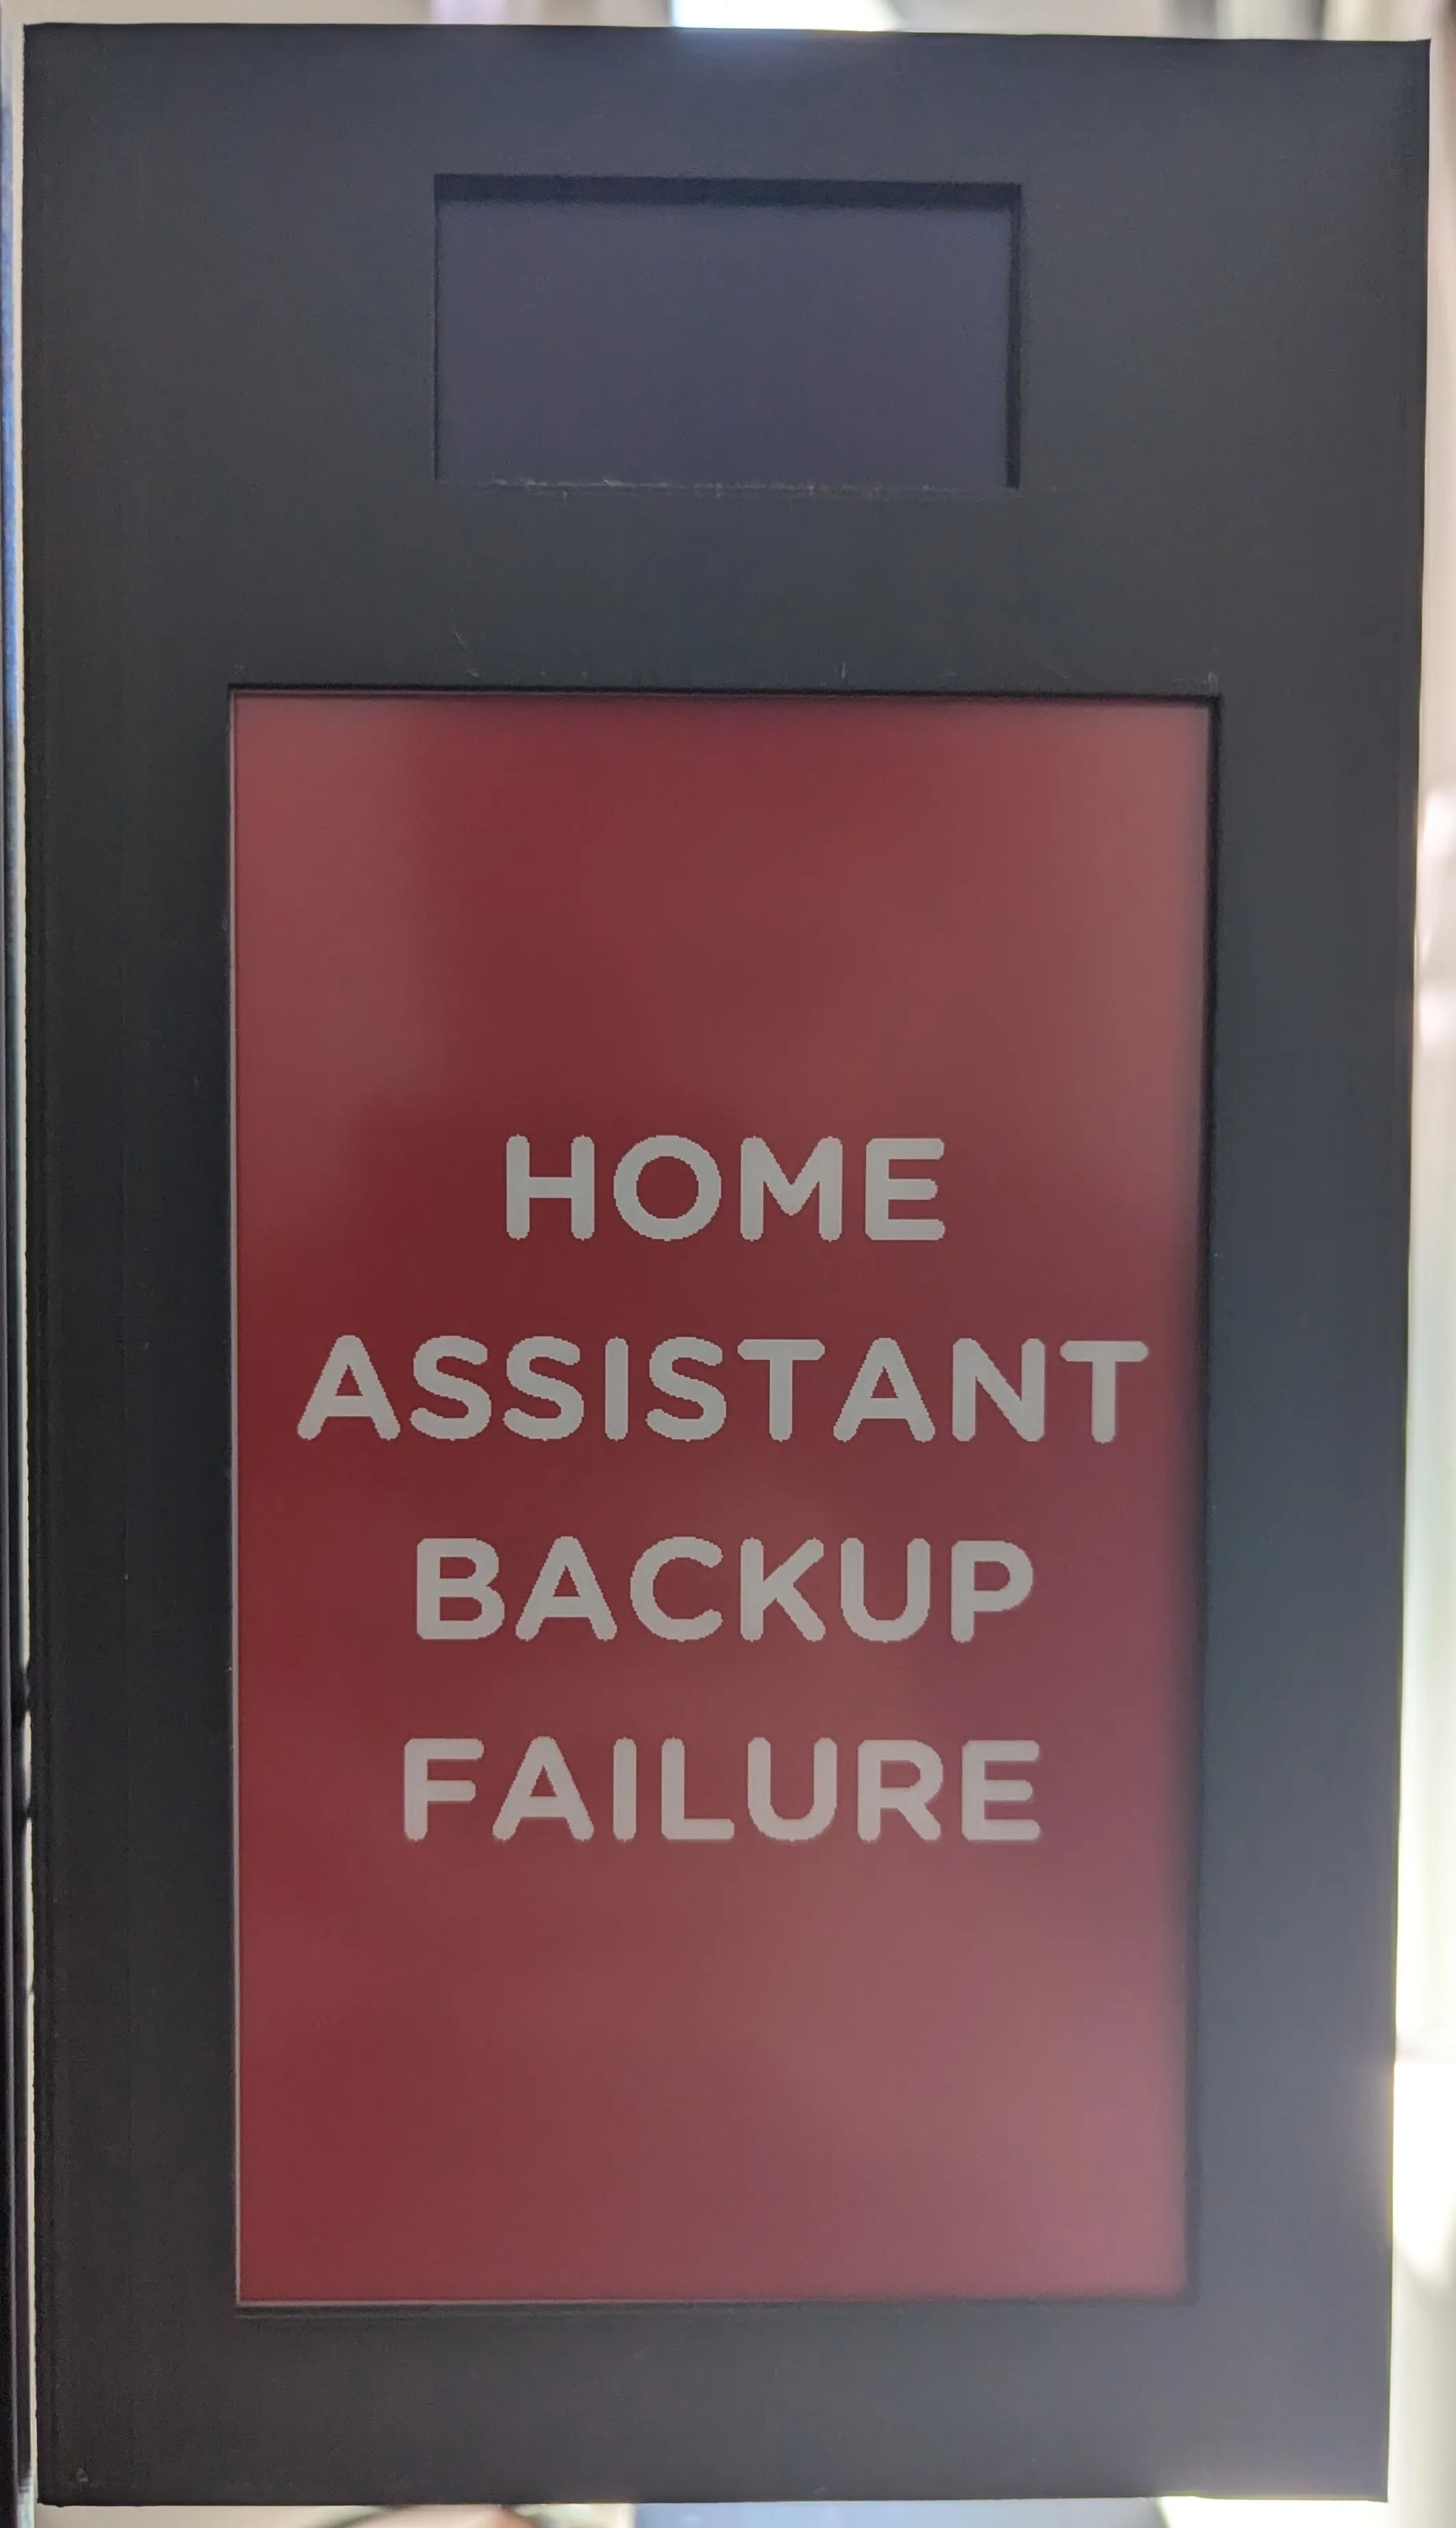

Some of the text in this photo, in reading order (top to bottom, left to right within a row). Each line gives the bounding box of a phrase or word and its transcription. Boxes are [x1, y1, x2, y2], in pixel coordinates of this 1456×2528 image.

[506, 1135, 945, 1241] HOME
[298, 1335, 1149, 1443] ASSISTANT
[416, 1536, 1034, 1643] BACKUP
[401, 1736, 1042, 1844] FAILURE
